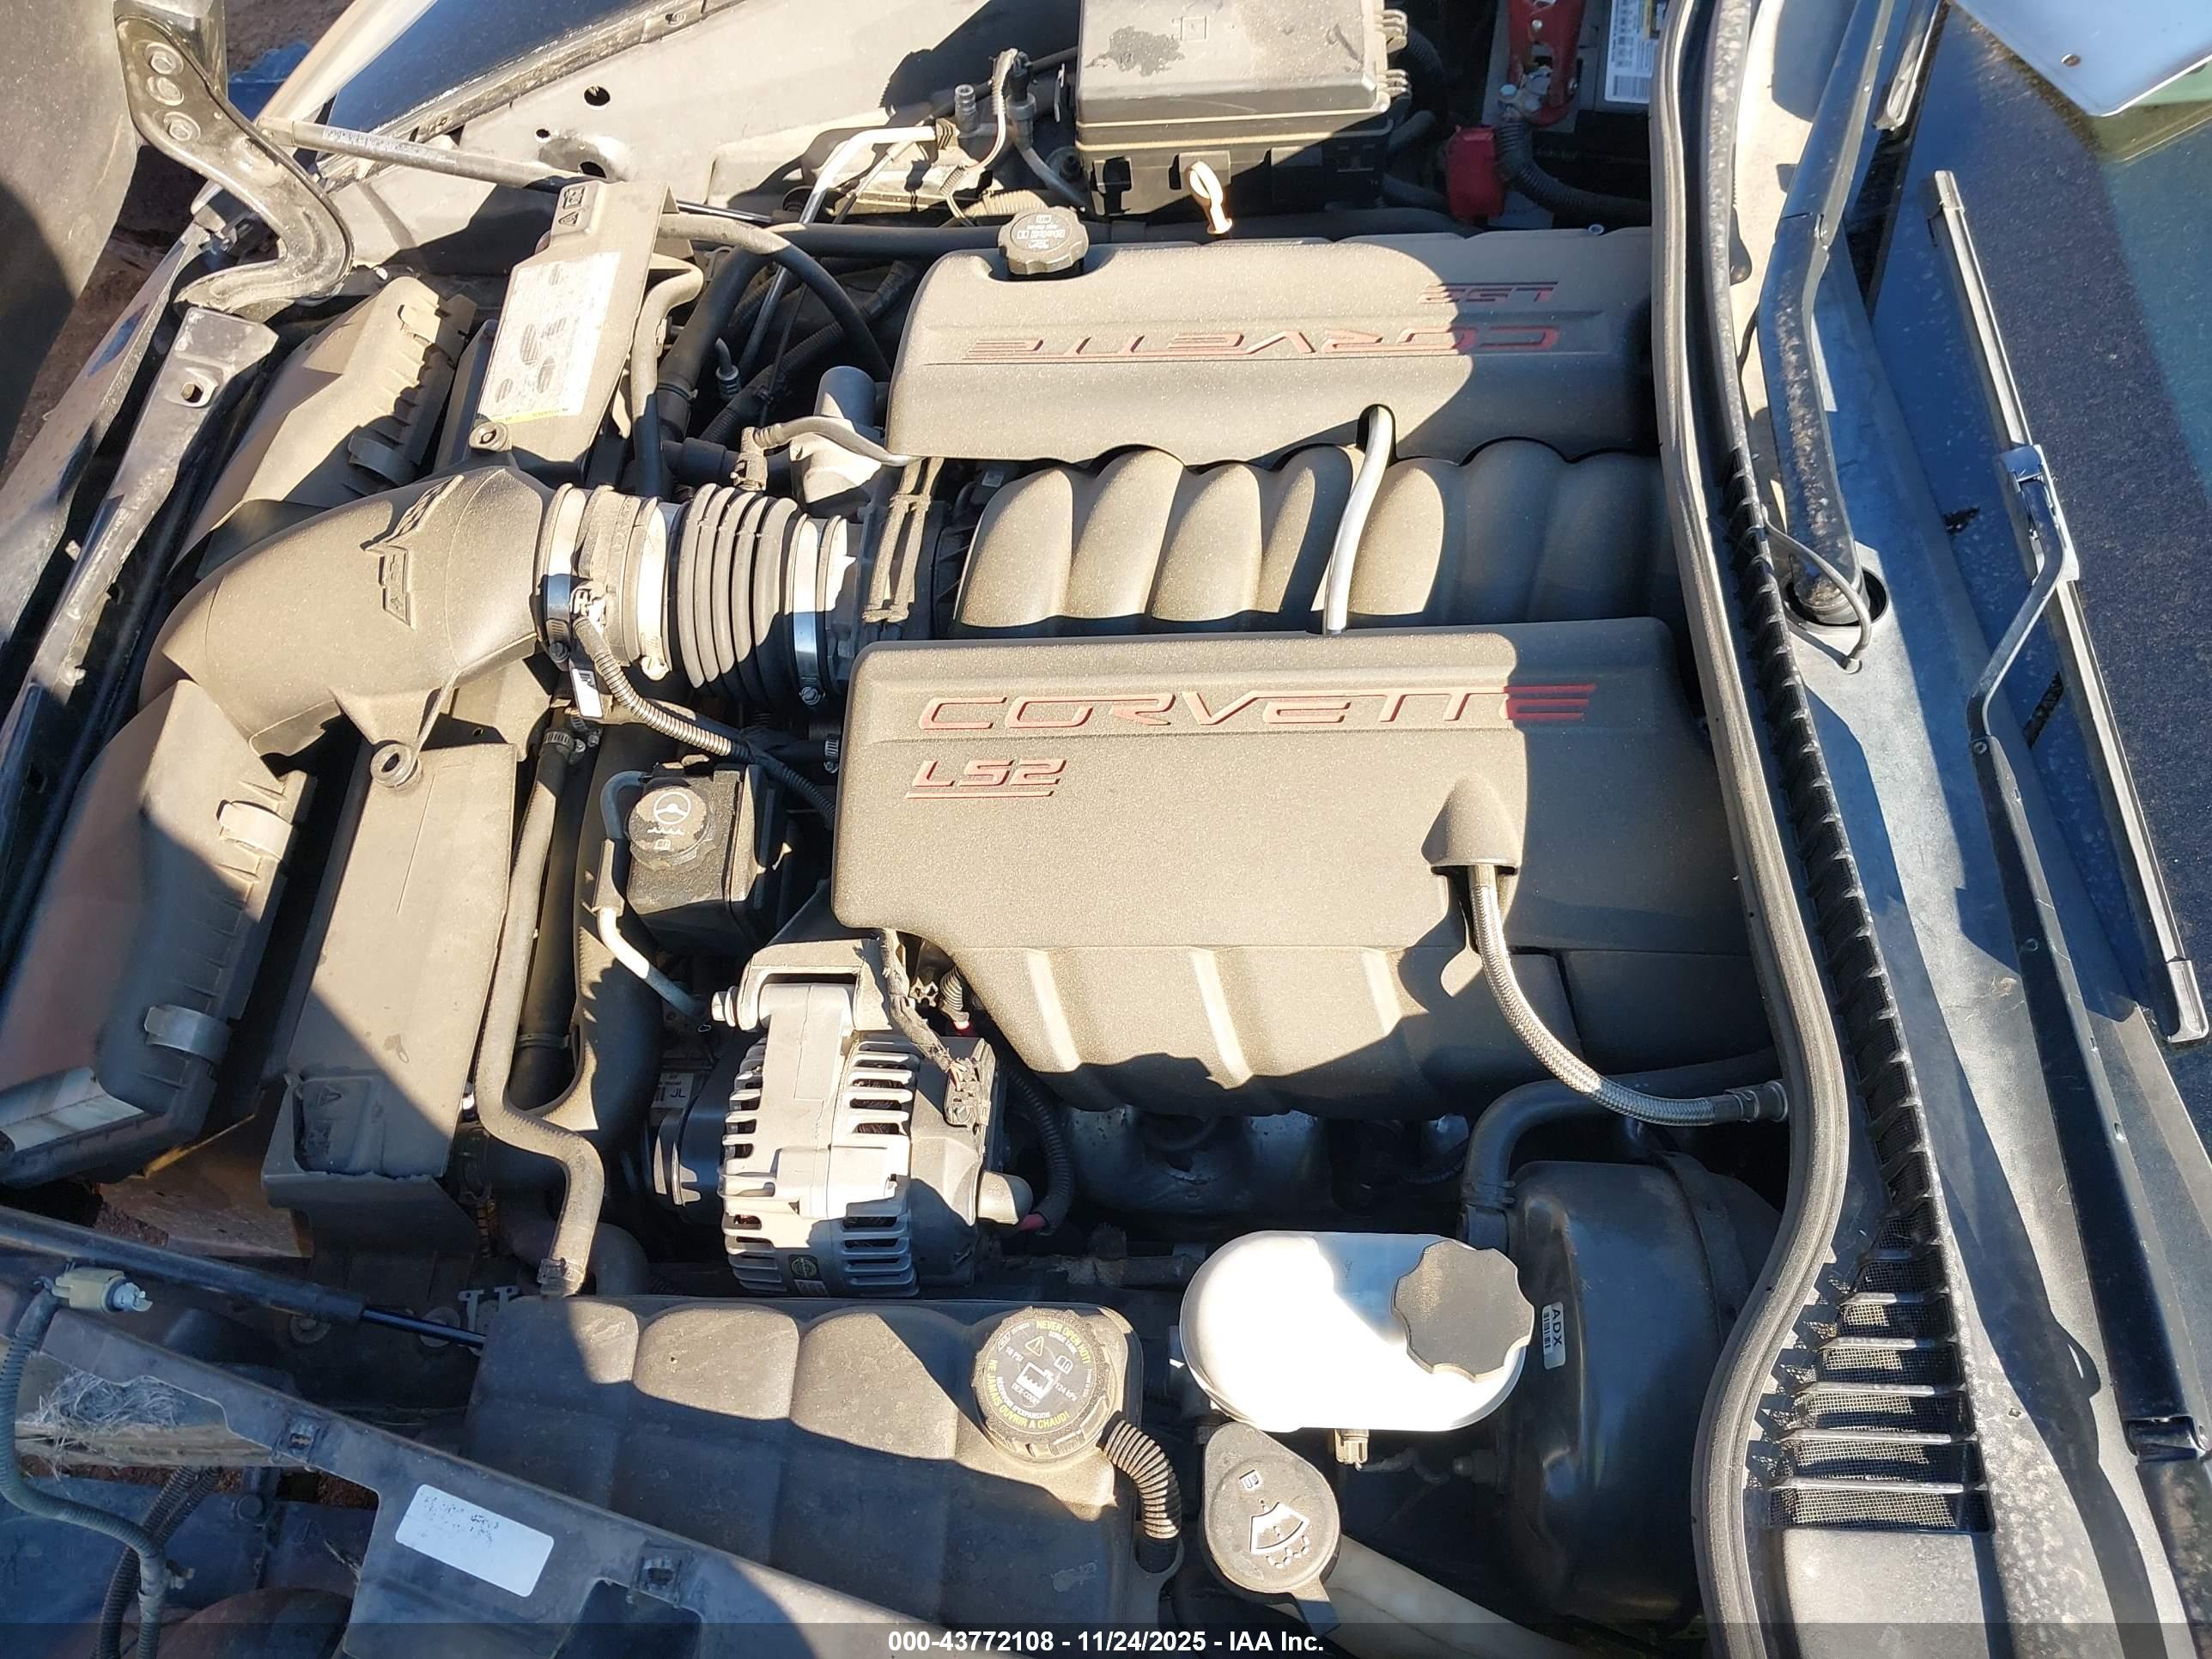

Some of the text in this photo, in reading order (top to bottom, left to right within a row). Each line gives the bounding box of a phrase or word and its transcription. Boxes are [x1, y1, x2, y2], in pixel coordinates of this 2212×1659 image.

[1417, 285, 1554, 305] LS2
[963, 326, 1559, 362] CORVETTE
[919, 683, 1597, 730] CORVETTE
[913, 757, 1068, 787] LS2
[1036, 1319, 1063, 1332] NEVER
[1062, 1327, 1082, 1346] OPEN
[1552, 1309, 1562, 1346] ADX
[988, 1359, 999, 1374] NE
[987, 1374, 1002, 1407] JAMAIS
[999, 1404, 1028, 1427] OUVRIR
[1036, 1410, 1071, 1429] CHAUD!
